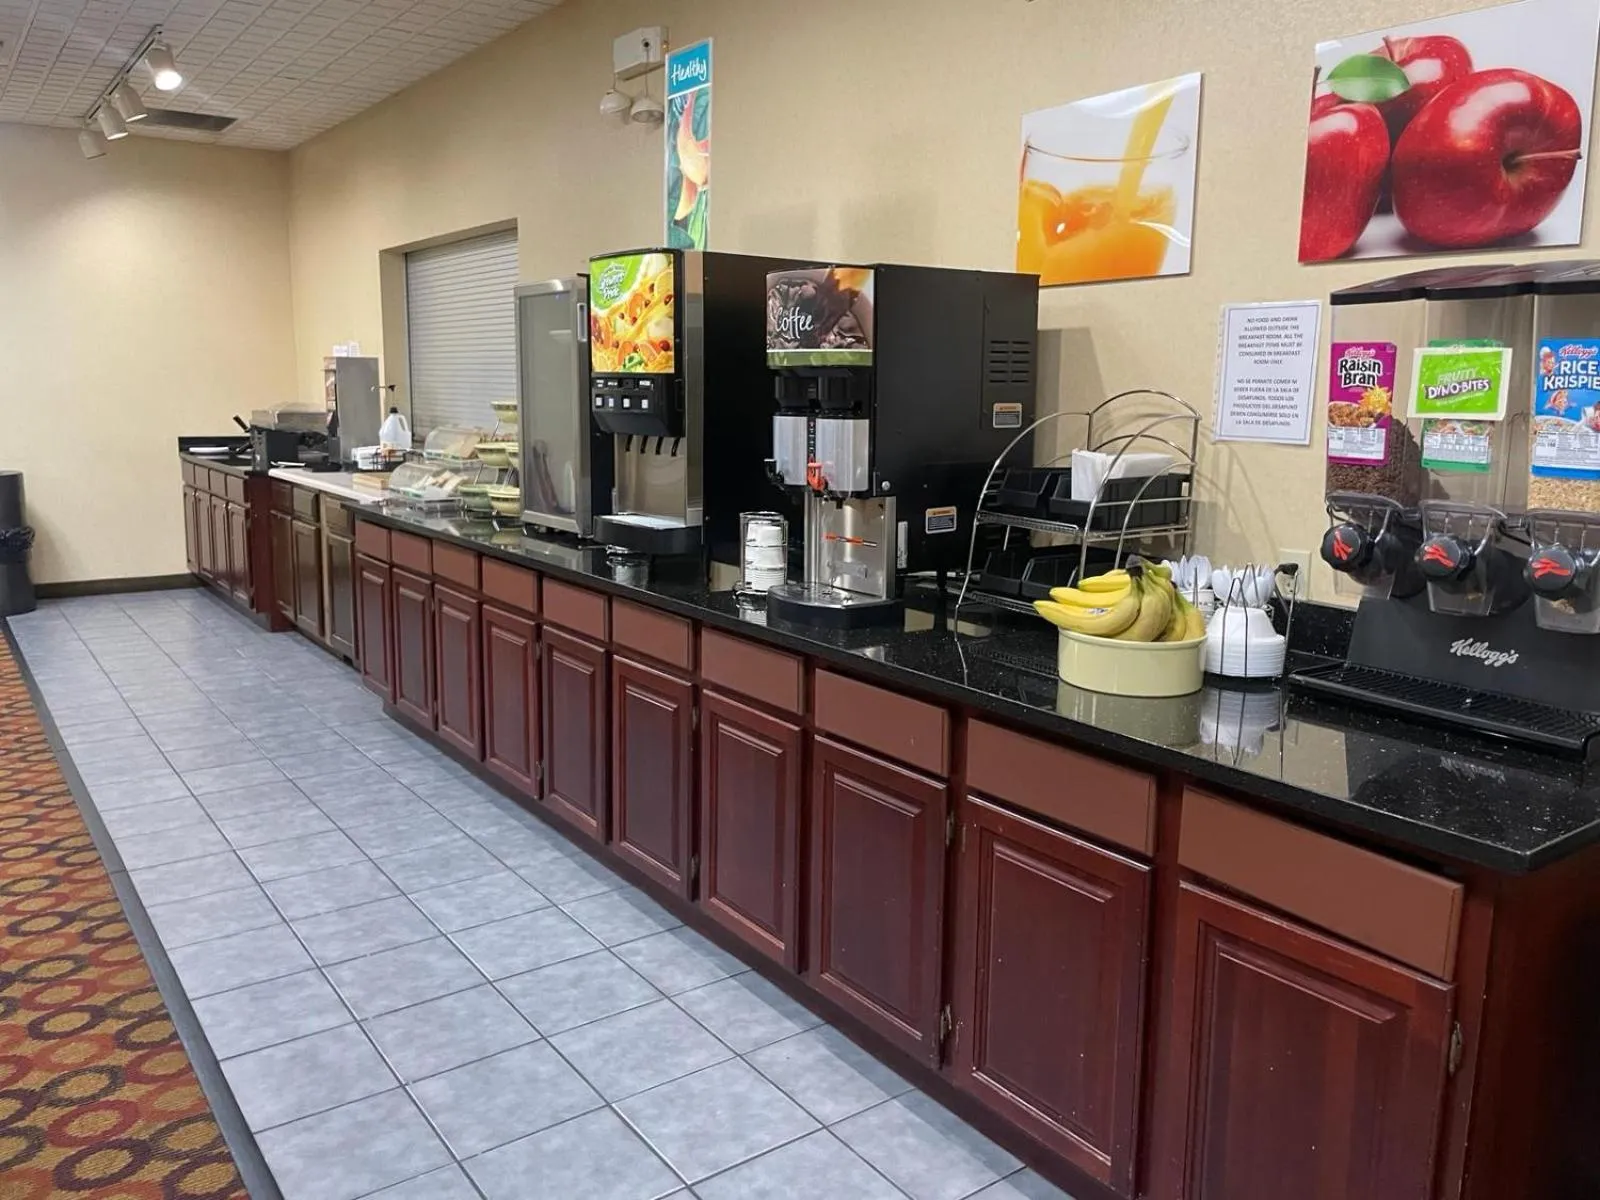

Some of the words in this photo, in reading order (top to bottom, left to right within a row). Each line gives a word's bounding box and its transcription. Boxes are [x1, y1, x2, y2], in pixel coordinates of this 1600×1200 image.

[671, 56, 707, 86] Healthy
[776, 306, 814, 339] Coffee
[1339, 358, 1382, 375] Raisin
[1560, 360, 1598, 375] RICE
[1342, 372, 1377, 387] Bran
[1450, 638, 1519, 667] Kellogg's
